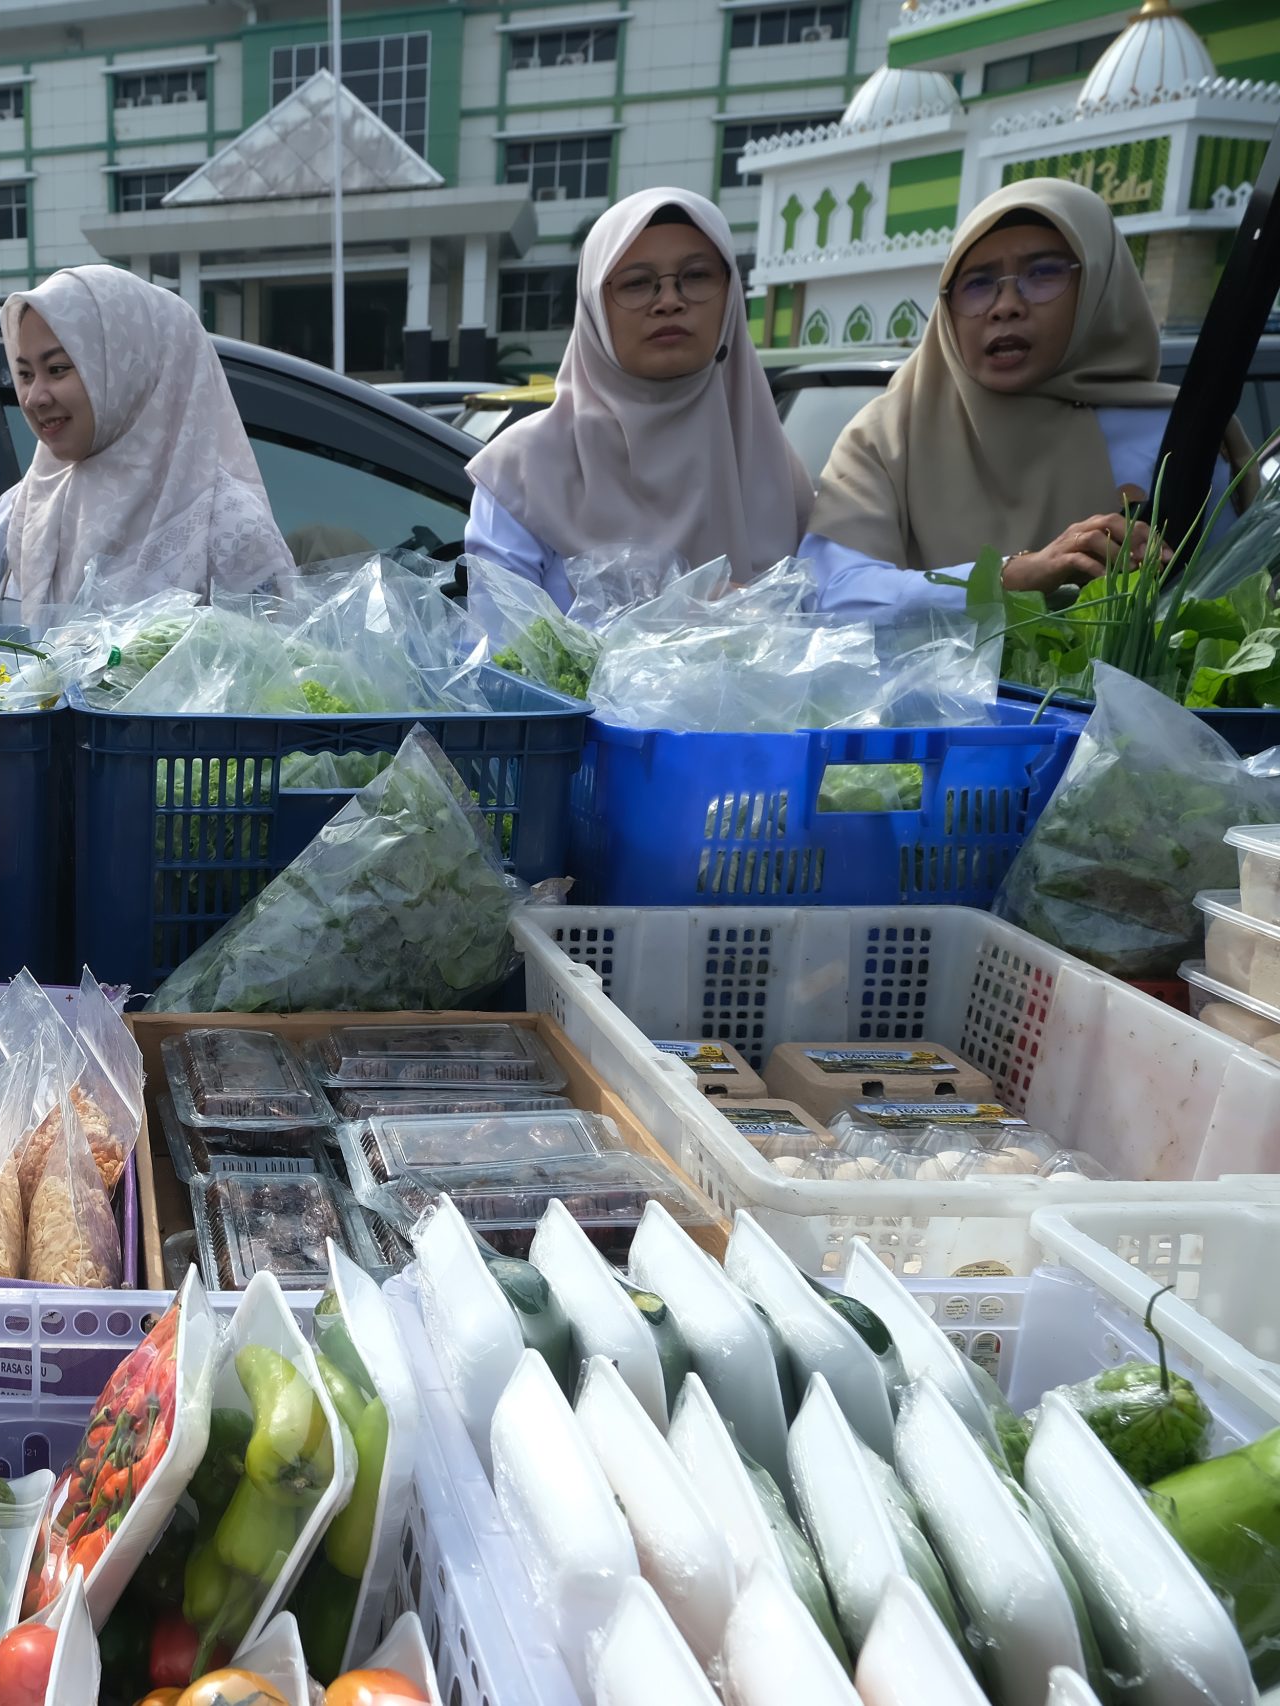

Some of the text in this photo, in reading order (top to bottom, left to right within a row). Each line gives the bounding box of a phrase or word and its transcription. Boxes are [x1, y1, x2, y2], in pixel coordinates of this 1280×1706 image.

[1, 1362, 47, 1377] RASA SU
[24, 1448, 38, 1457] 21
